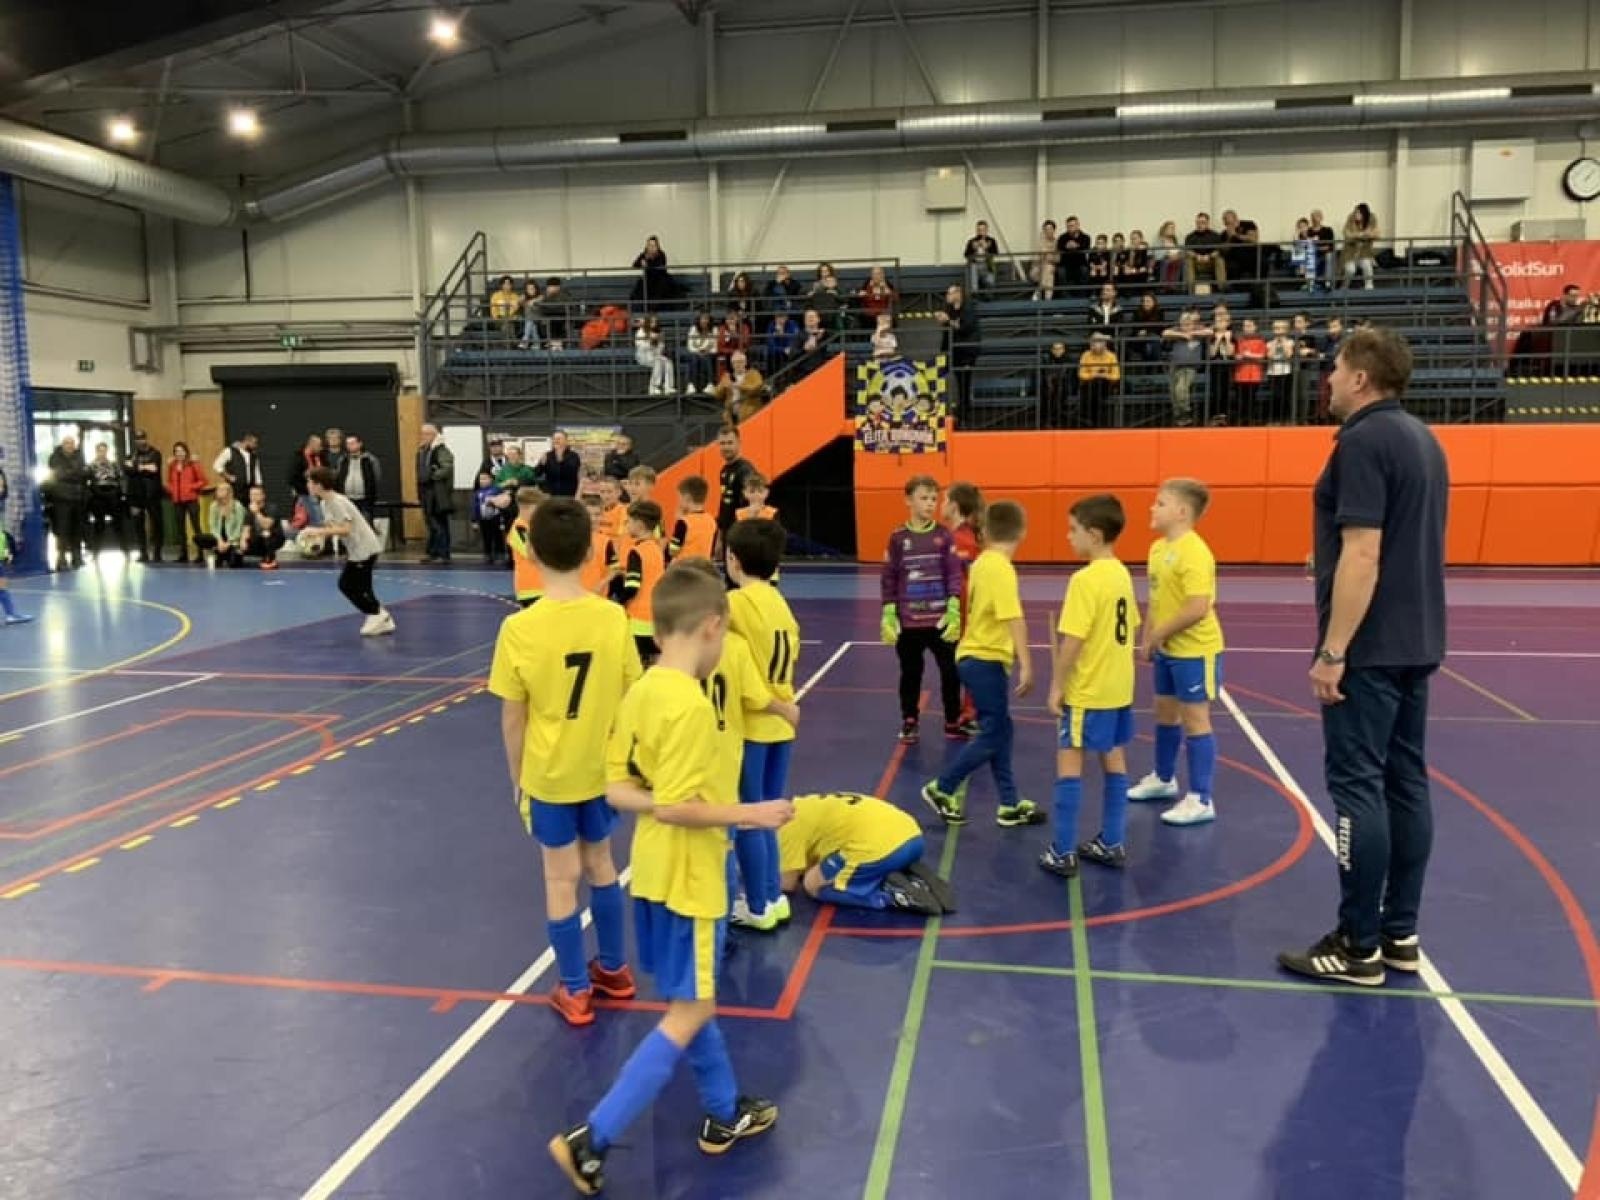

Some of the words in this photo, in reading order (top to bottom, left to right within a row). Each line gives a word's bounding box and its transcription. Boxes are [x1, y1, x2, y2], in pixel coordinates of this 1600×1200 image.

[1116, 597, 1128, 645] 8
[768, 629, 792, 684] 11
[564, 651, 594, 721] 7
